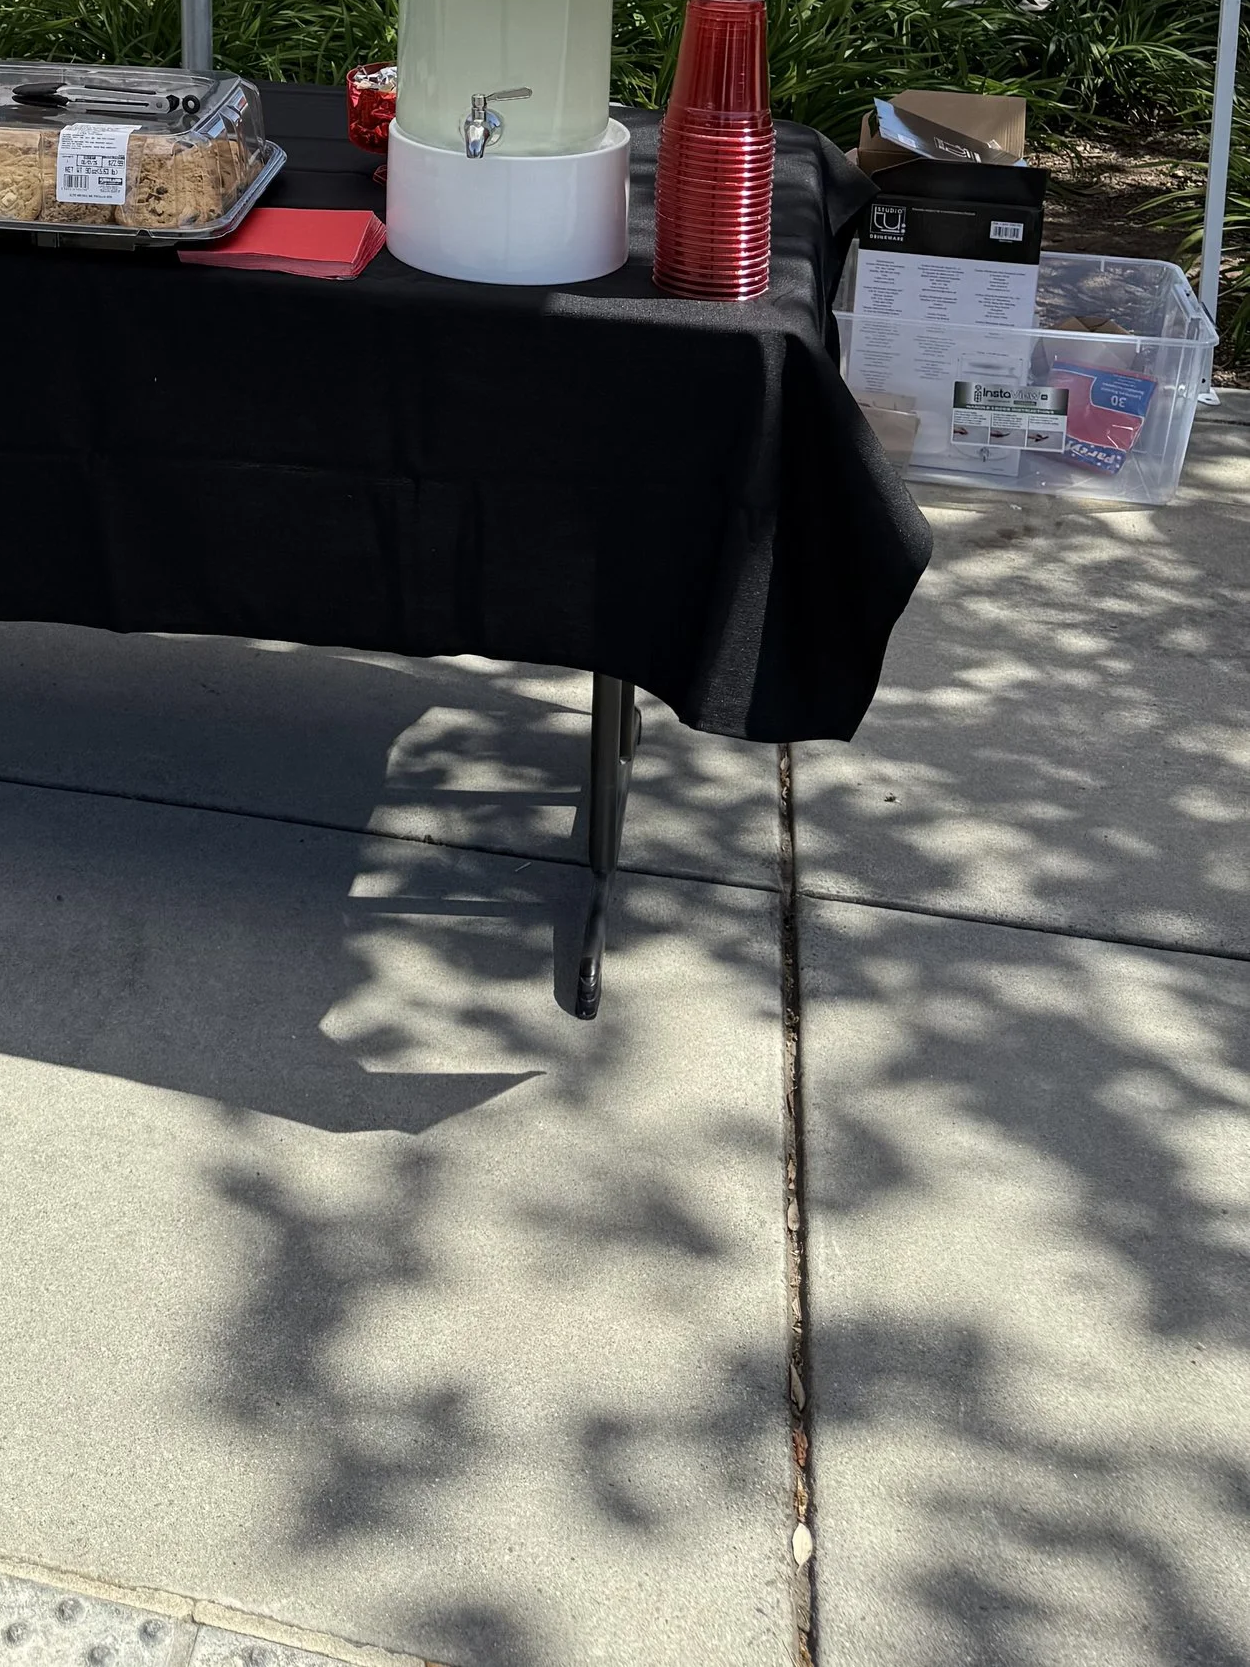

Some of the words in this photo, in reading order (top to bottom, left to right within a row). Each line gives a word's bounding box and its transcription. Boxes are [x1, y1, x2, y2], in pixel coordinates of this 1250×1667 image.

[870, 234, 904, 242] DRINKWARE
[983, 387, 1040, 400] InstaView
[1110, 395, 1127, 408] 30
